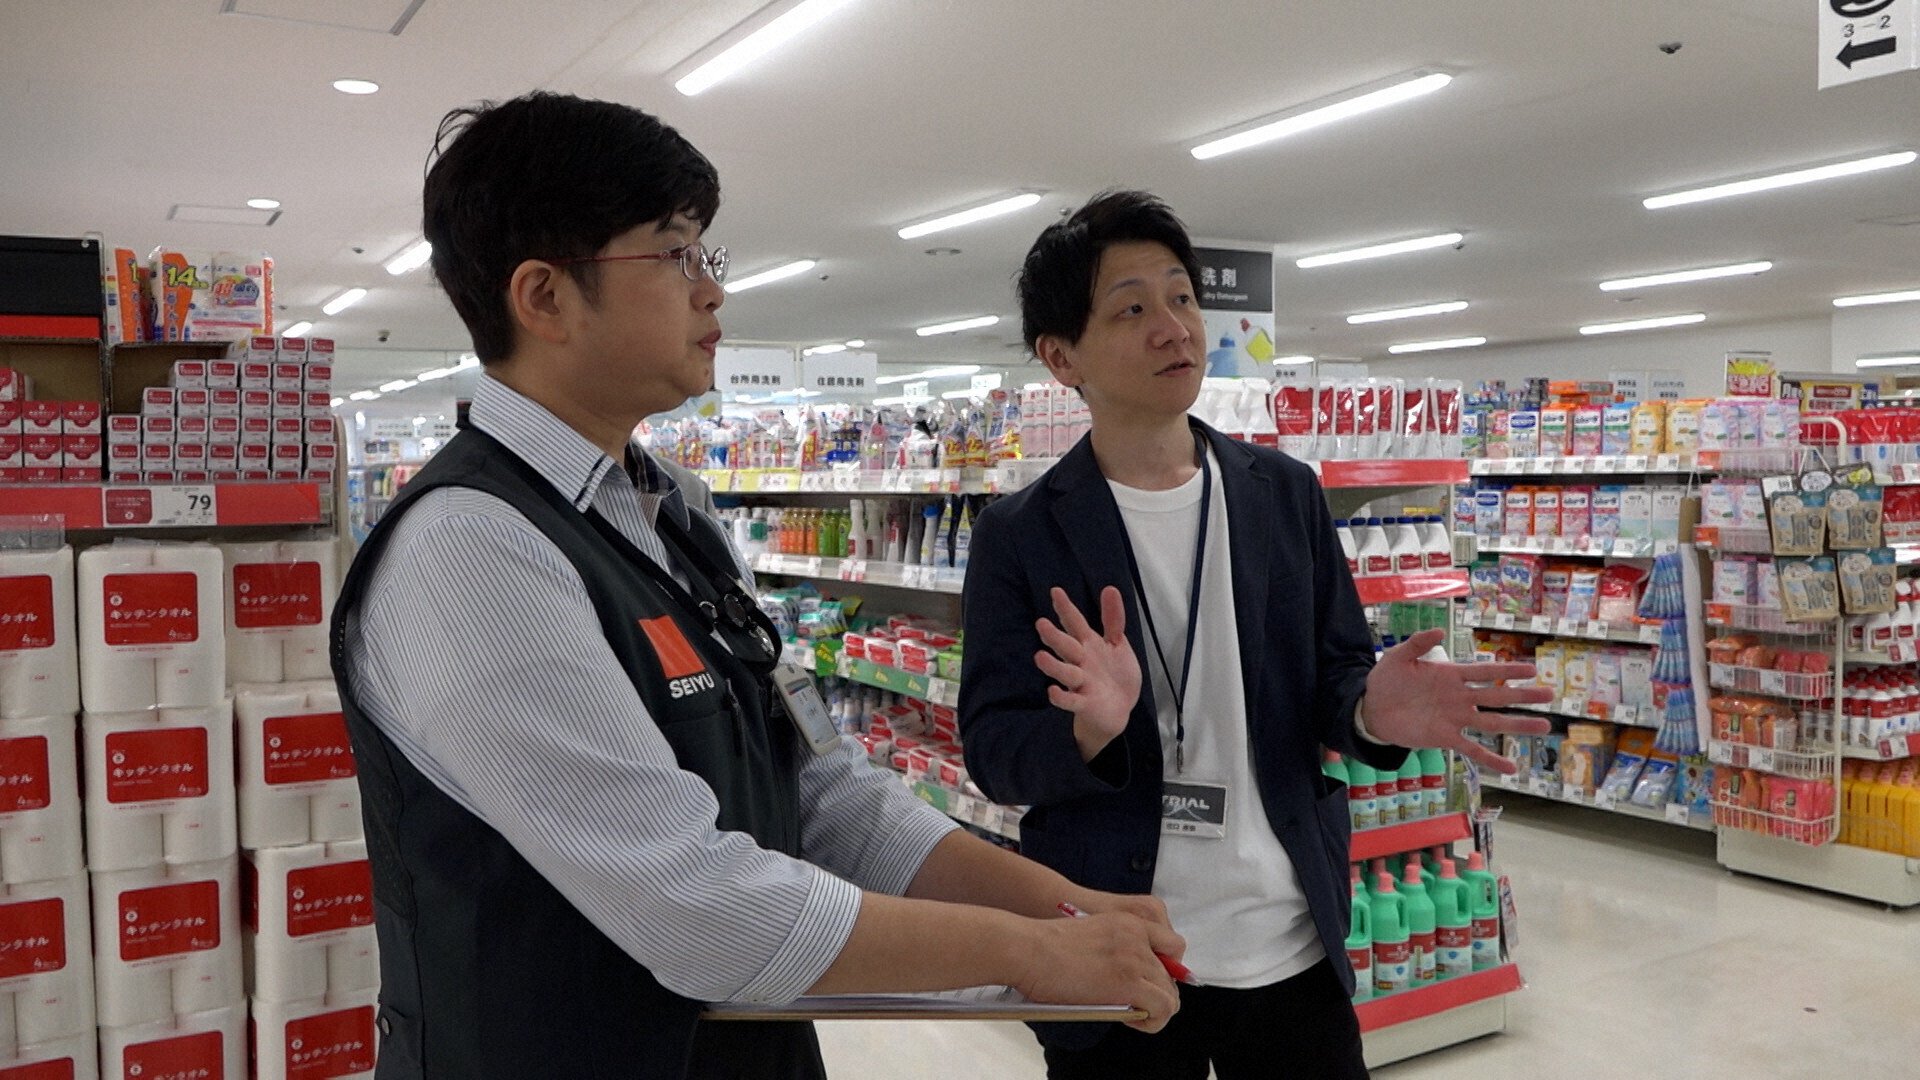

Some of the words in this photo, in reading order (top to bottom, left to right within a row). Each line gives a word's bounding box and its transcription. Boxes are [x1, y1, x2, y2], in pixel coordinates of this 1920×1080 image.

[187, 494, 211, 511] 79
[110, 607, 192, 621] キッチンタオル
[669, 672, 715, 699] SEIYU
[113, 762, 194, 778] キッチンタオル
[126, 916, 206, 936] キッチンタオル
